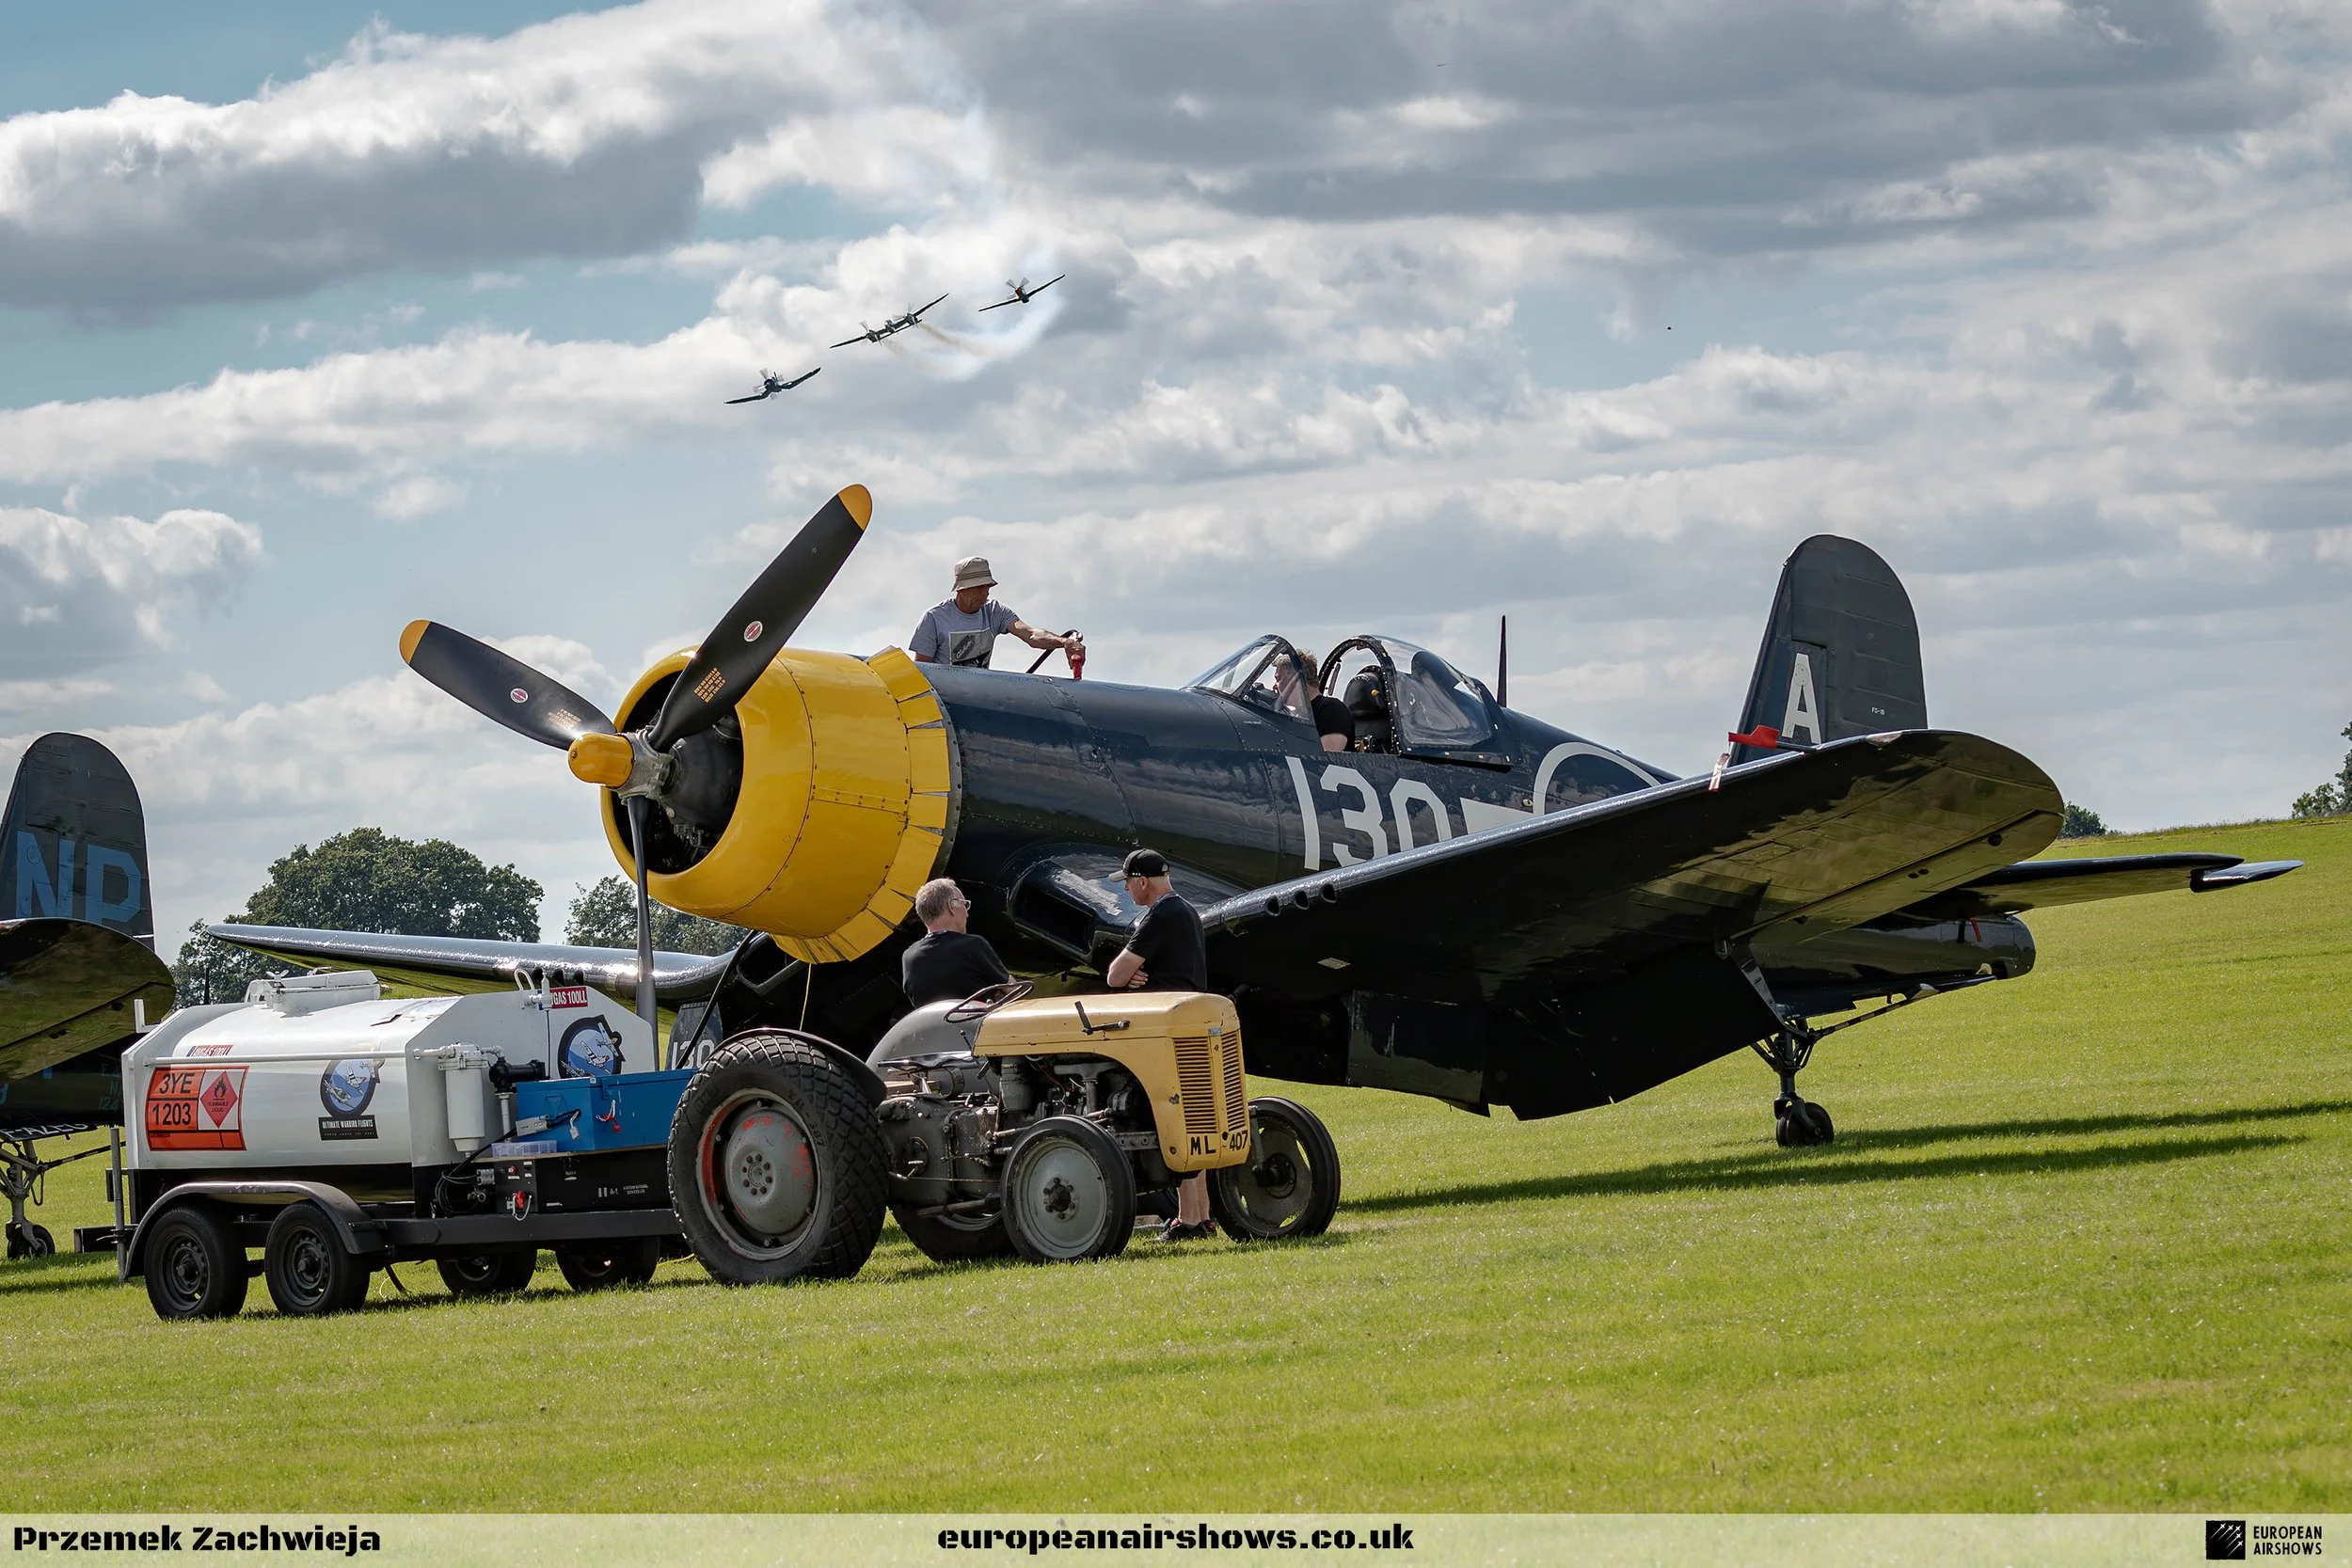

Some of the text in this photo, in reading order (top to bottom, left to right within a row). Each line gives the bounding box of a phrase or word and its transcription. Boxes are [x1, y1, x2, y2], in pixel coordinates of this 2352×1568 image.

[1782, 653, 1821, 744] A
[1285, 756, 1453, 871] 130
[16, 831, 141, 924] NP
[551, 991, 567, 1006] GAS
[159, 1073, 195, 1094] 3YE
[152, 1102, 191, 1126] 1203
[1190, 1130, 1248, 1155] ML 407
